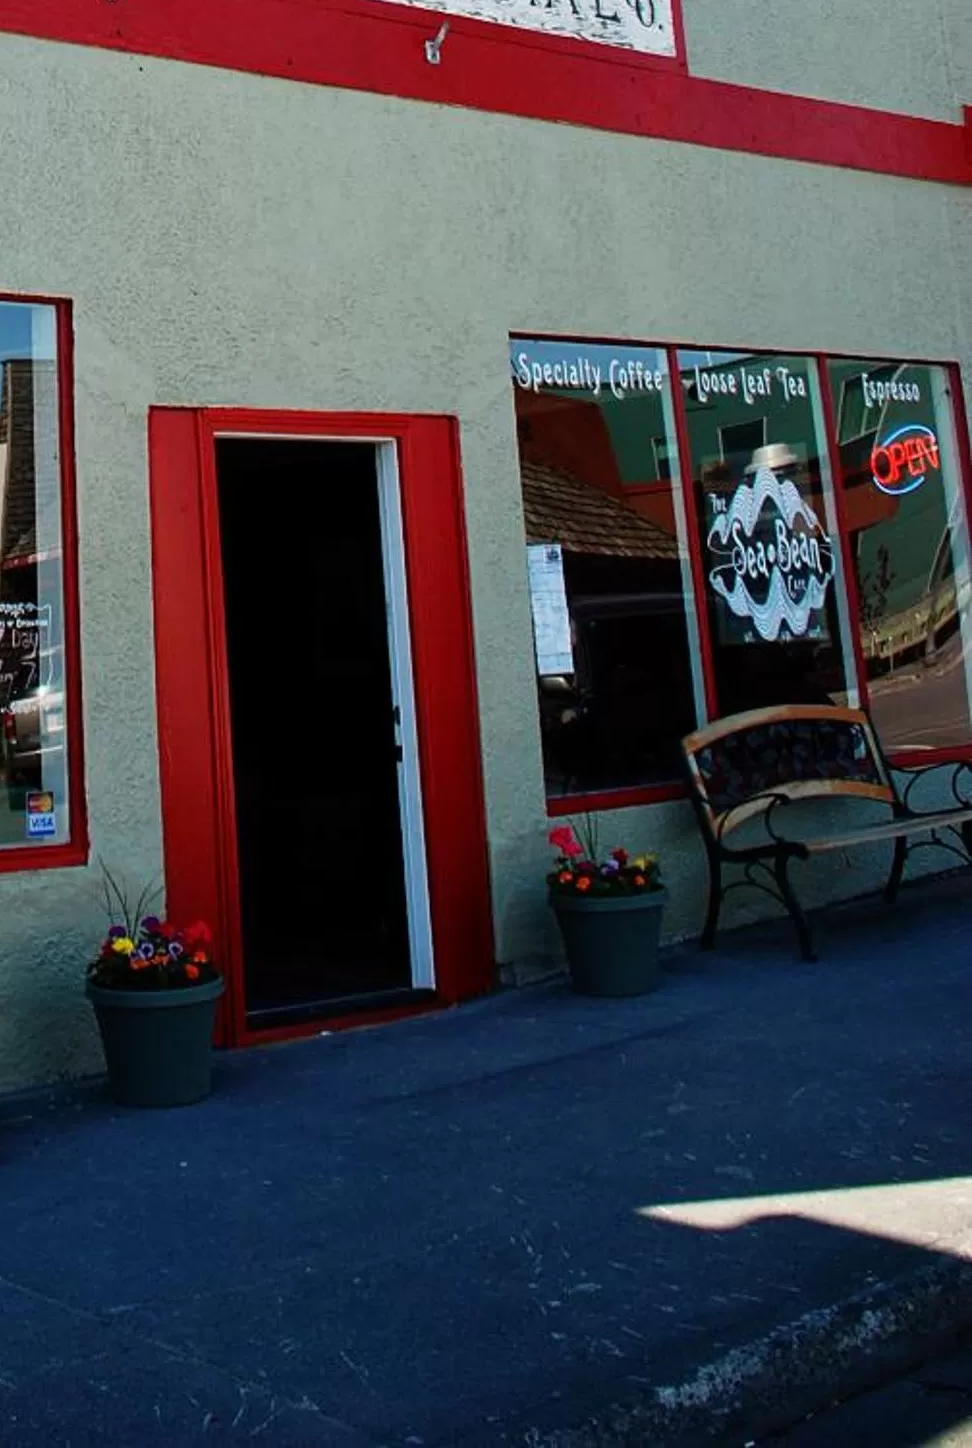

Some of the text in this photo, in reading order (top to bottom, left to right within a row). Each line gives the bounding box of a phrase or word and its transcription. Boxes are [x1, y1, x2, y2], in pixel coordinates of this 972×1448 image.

[517, 352, 663, 400] Specialty Coffee
[694, 364, 807, 405] Loose Leaf Tea
[861, 372, 920, 408] Espresso
[870, 435, 940, 484] OPEN
[31, 817, 54, 829] VISA
